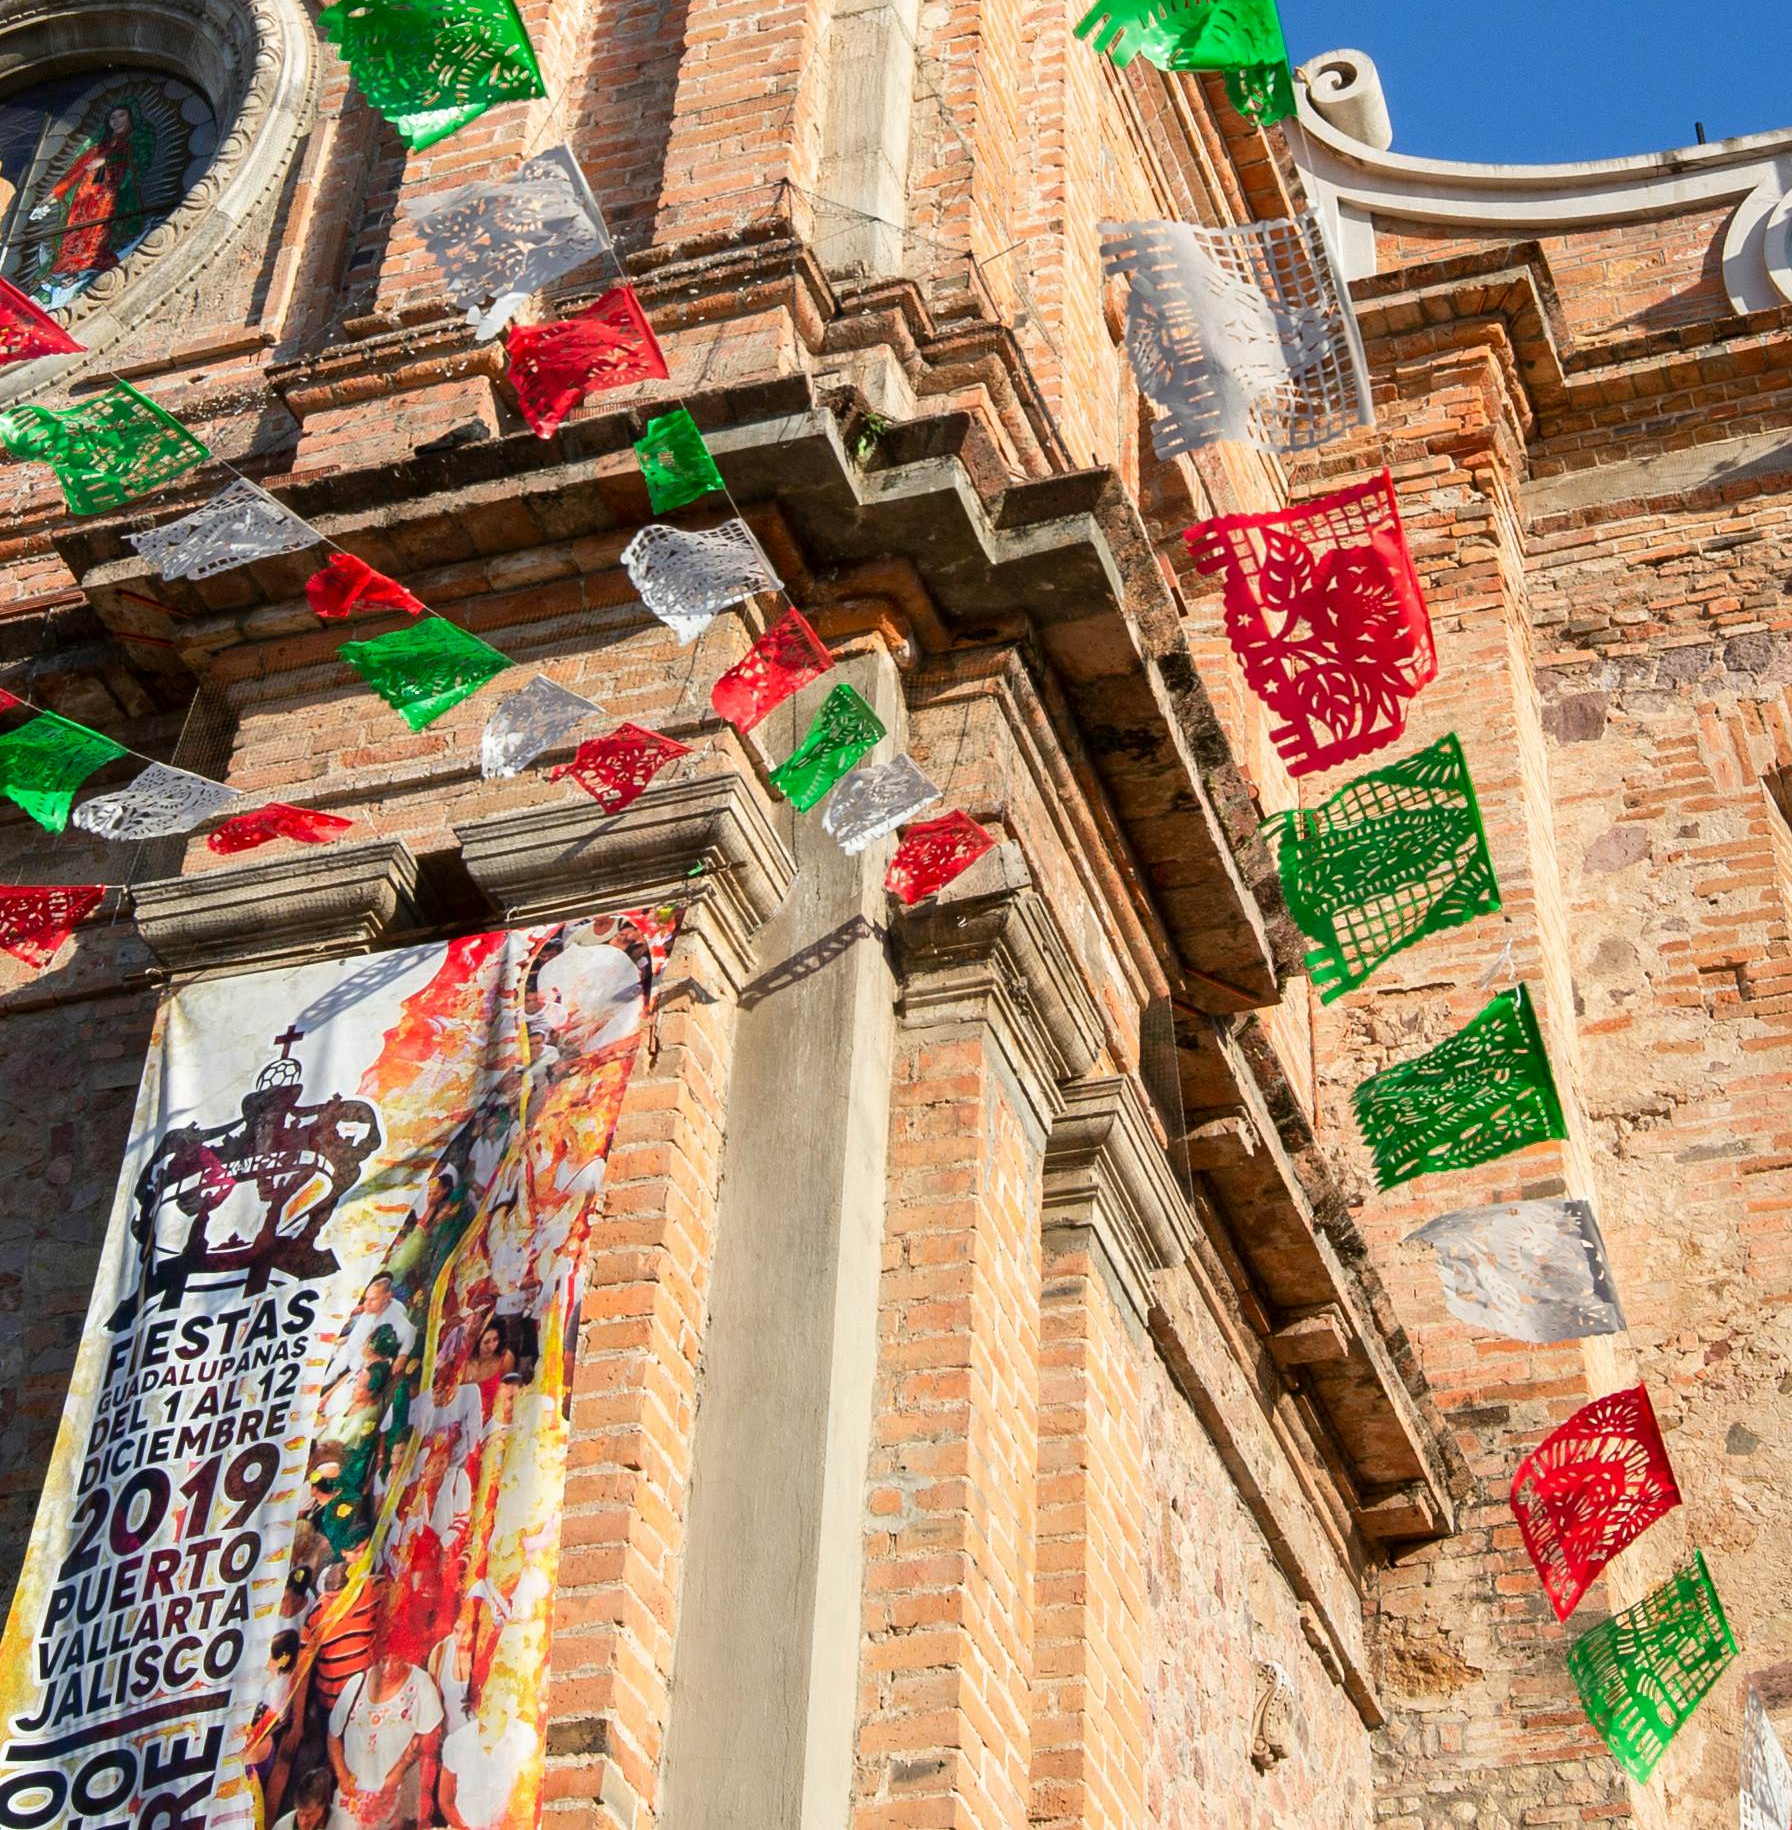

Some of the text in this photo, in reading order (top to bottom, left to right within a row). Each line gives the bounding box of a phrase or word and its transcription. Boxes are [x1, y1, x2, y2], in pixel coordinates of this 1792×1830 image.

[97, 1335, 309, 1417] GUADALUPANAS
[102, 1289, 320, 1391] FIESTAS
[76, 1400, 292, 1497] DICIEMBRE
[86, 1362, 301, 1457] DEL 1 AL 12
[57, 1441, 281, 1584] 2019
[38, 1584, 250, 1681] VALLARTA
[40, 1530, 263, 1639] PUERTO
[14, 1628, 245, 1733] JALISCO
